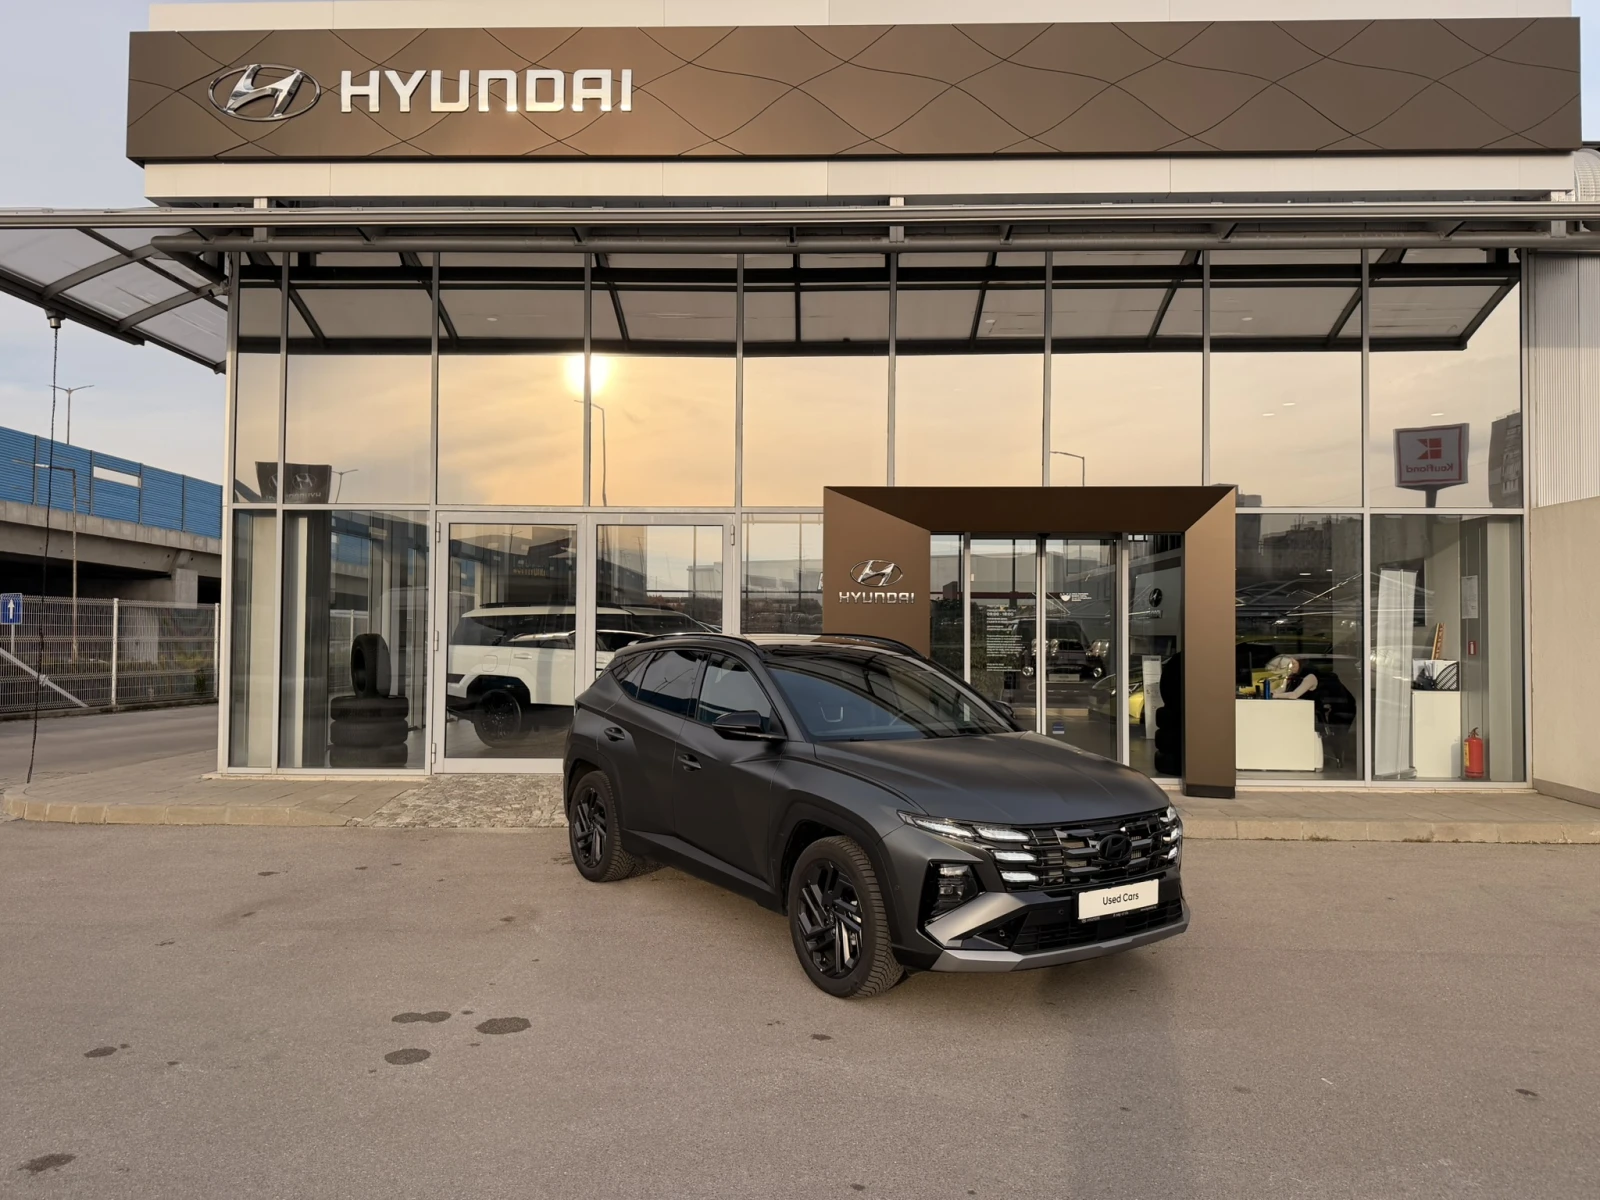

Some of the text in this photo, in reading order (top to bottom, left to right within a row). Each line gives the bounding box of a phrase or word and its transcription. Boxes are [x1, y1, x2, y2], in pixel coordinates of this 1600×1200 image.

[341, 69, 632, 112] HYUNDAI
[838, 591, 915, 604] HYUNDAI
[1102, 892, 1139, 905] Used Cars
